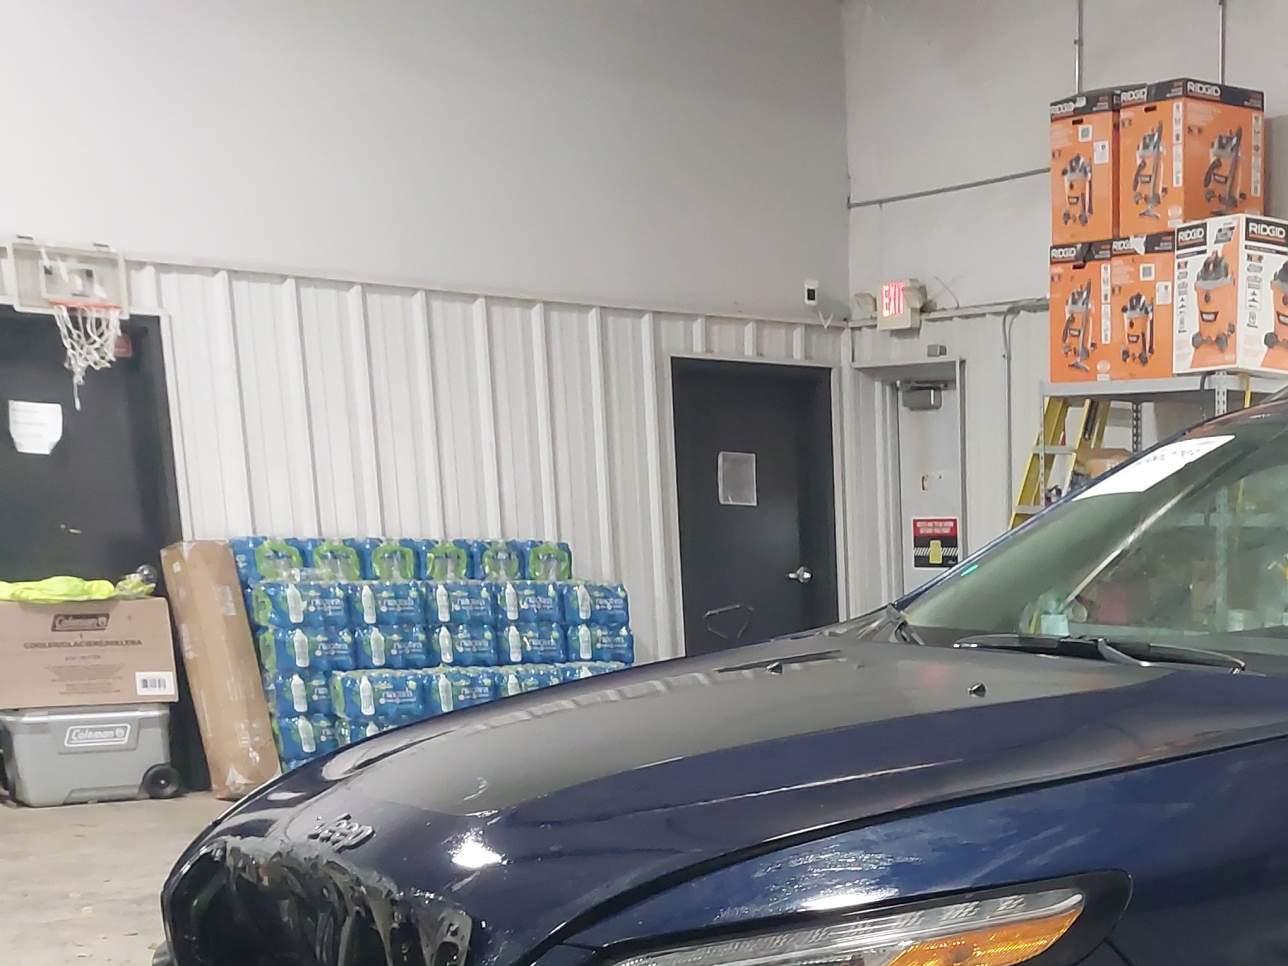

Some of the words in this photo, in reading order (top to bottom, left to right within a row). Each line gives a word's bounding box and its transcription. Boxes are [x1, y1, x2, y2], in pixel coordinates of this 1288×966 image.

[1187, 81, 1221, 96] RIDGID
[1178, 227, 1205, 241] RIDGID
[1249, 222, 1286, 239] RIDGID
[882, 283, 904, 316] EXIT
[71, 729, 114, 740] Coleman
